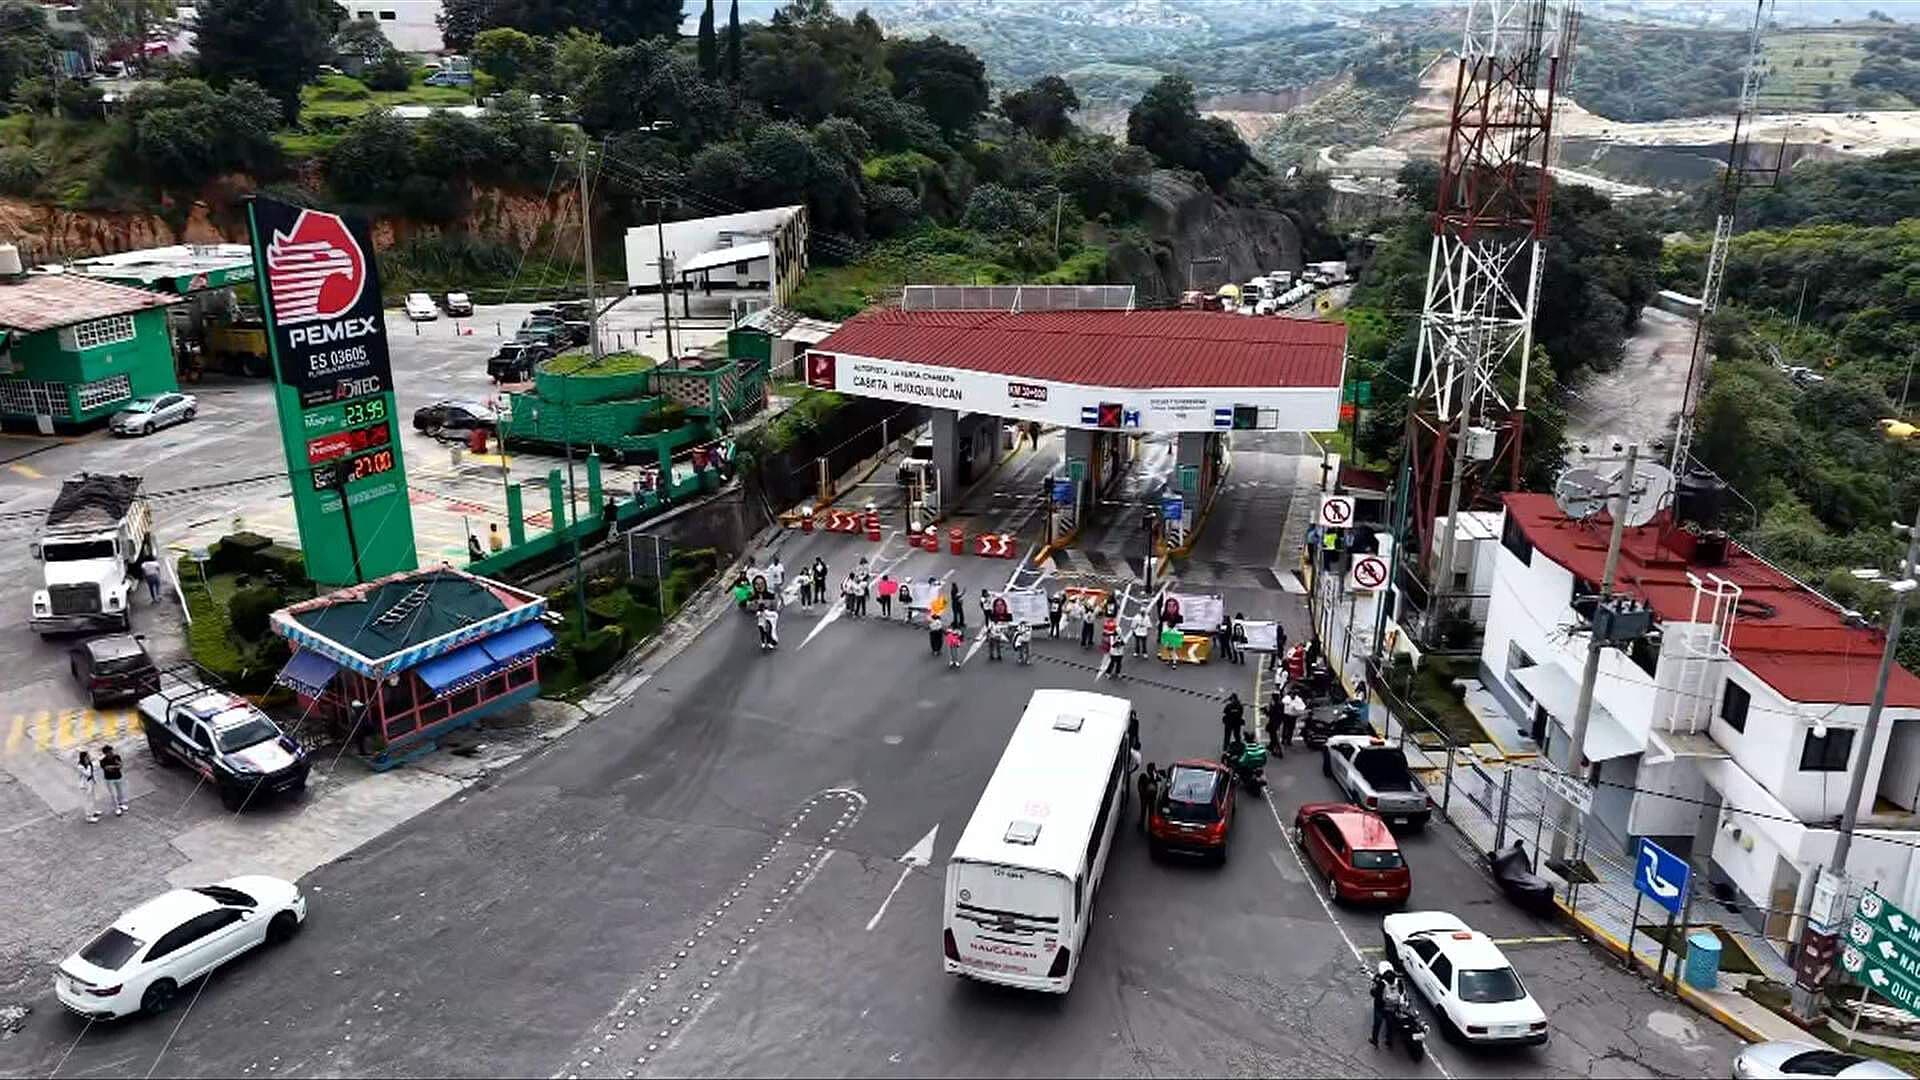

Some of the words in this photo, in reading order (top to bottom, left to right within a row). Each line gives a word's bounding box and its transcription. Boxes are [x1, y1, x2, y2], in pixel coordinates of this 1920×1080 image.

[289, 315, 377, 348] PEMEX
[309, 353, 328, 370] ES
[330, 345, 367, 366] 03605
[853, 375, 888, 390] CASETA
[894, 382, 962, 400] HUIXQUILUCAN
[347, 400, 385, 424] 23.99
[354, 451, 392, 478] 27.00
[1864, 900, 1877, 912] 57
[970, 943, 1037, 959] NAUCALPAN
[1847, 952, 1858, 966] 57
